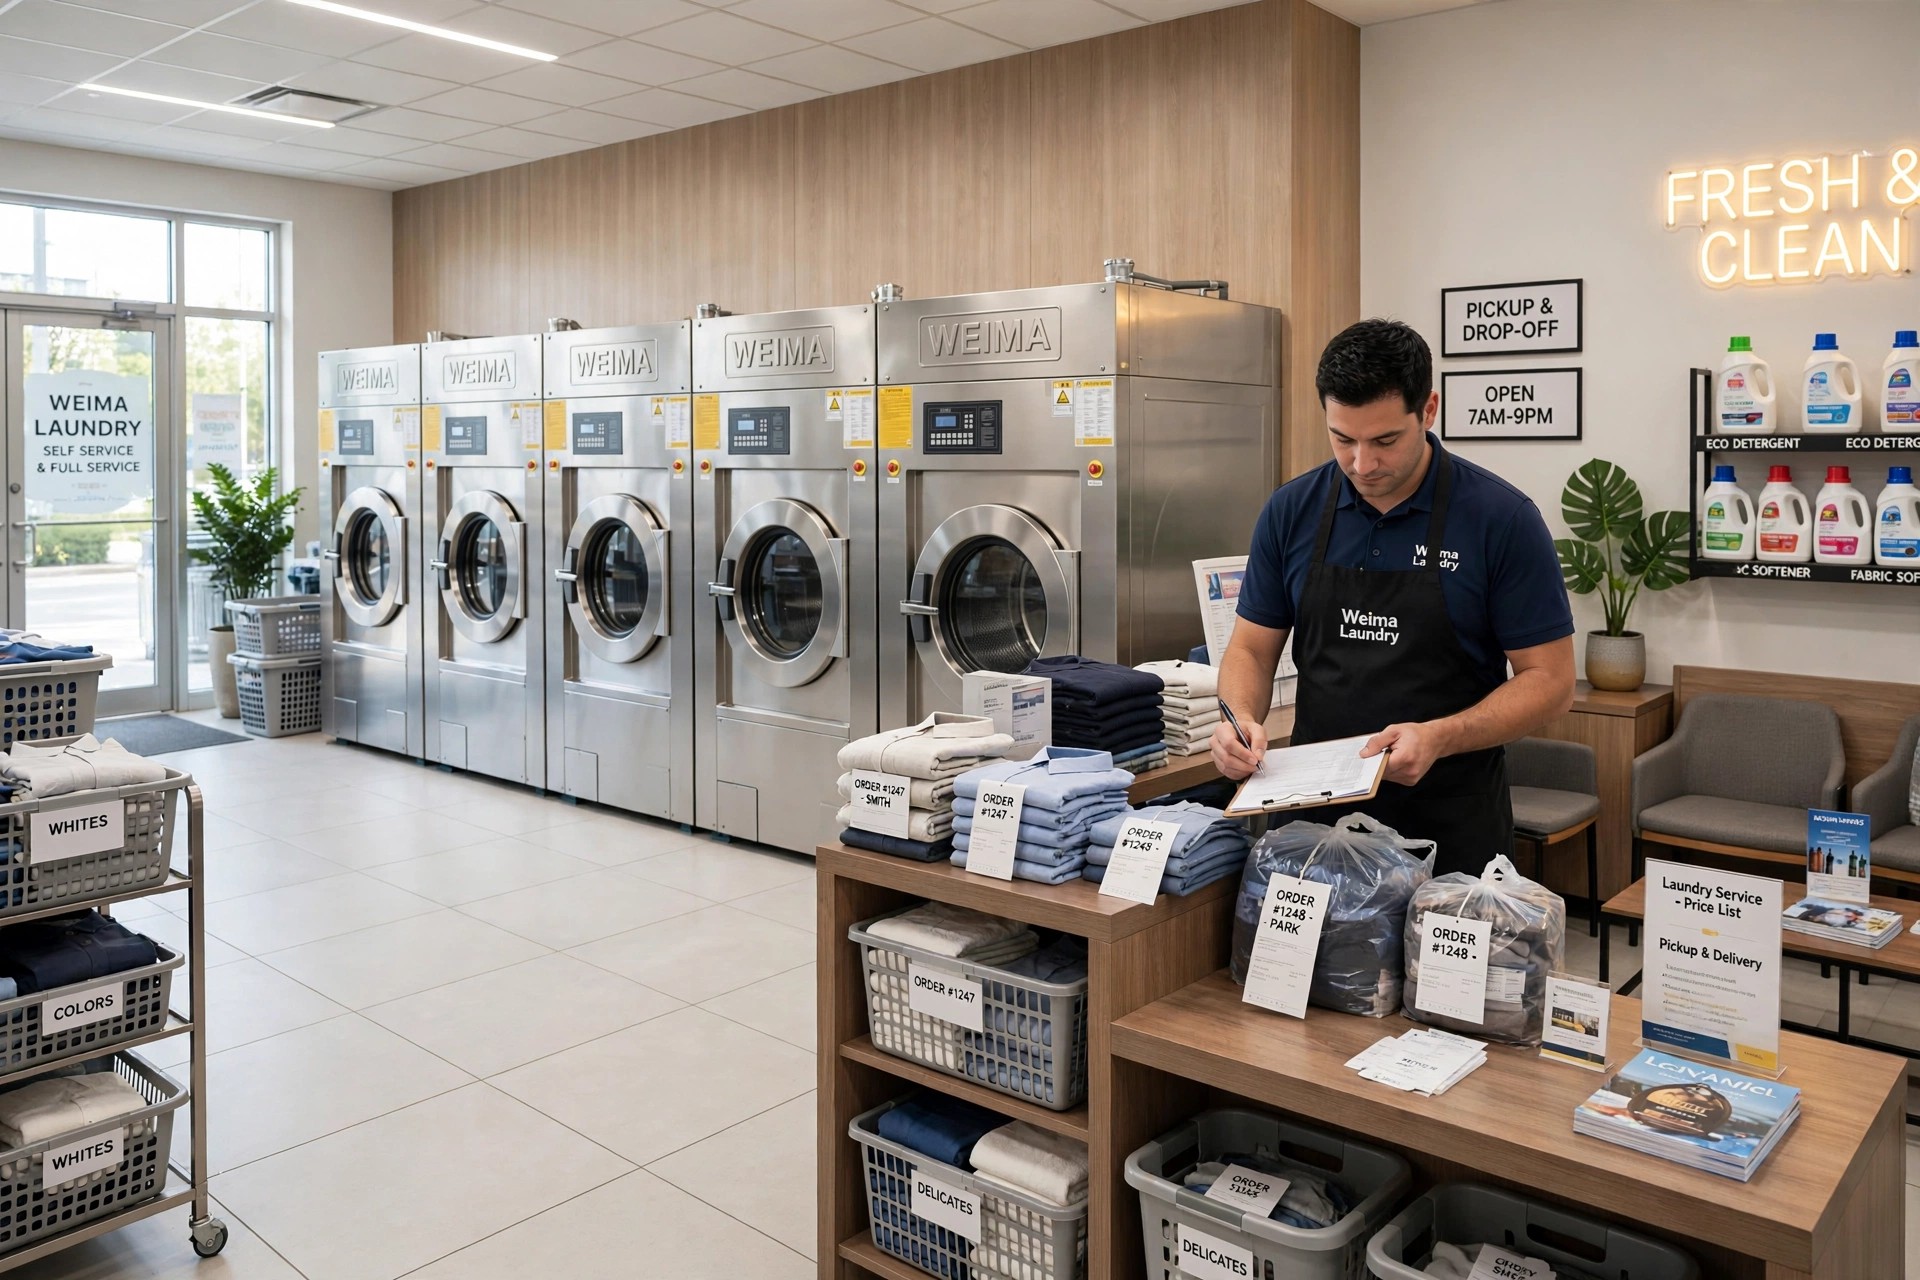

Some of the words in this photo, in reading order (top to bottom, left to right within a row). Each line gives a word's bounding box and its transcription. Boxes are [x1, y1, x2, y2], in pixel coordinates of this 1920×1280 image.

[1667, 153, 1859, 225] FRESH
[1886, 148, 1920, 204] &
[1701, 217, 1900, 283] CLEAN
[1466, 299, 1535, 319] PICKUP
[1540, 297, 1554, 314] &
[929, 318, 1053, 357] WEIMA
[1463, 319, 1559, 341] DROP-OFF
[733, 334, 829, 368] WEIMA
[450, 358, 512, 384] WEIMA
[577, 348, 654, 377] WEIMA
[342, 366, 394, 391] WEIMA
[49, 394, 128, 412] WEIMA
[1485, 385, 1534, 403] OPEN
[1468, 407, 1553, 425] 7AM-9PM
[34, 419, 142, 437] LAUNDRY
[43, 445, 75, 456] SELF
[80, 445, 134, 456] SERVICE
[1706, 438, 1729, 449] ECO
[1733, 437, 1800, 449] DETERGENT
[1846, 437, 1871, 449] ECO
[37, 463, 46, 473] &
[50, 463, 83, 473] FULL
[87, 462, 141, 472] SERVICE
[1752, 564, 1811, 578] SOFTENER
[1850, 569, 1893, 582] FABRIC
[1341, 608, 1398, 628] Weima
[1340, 624, 1400, 645] Laundry
[854, 779, 881, 792] ORDER
[866, 794, 891, 808] SMITH
[983, 793, 1014, 808] ORDER
[981, 808, 1008, 820] #1247
[48, 814, 108, 836] WHITES
[1127, 827, 1163, 841] ORDER
[1276, 889, 1315, 908] ORDER
[1662, 876, 1712, 899] Laundry
[1715, 886, 1763, 906] Service
[1273, 904, 1307, 921] #1248
[1684, 896, 1714, 914] Price
[1718, 903, 1742, 919] List
[1270, 918, 1301, 936] PARK
[1432, 927, 1476, 946] ORDER
[1432, 943, 1468, 960] #1248
[1659, 937, 1698, 959] Pickup
[1701, 947, 1710, 959] &
[1713, 949, 1762, 972] Delivery
[914, 975, 945, 995] ORDER
[948, 987, 975, 1003] #1247
[53, 994, 114, 1021] COLORS
[52, 1139, 114, 1170] WHITES
[1232, 1175, 1270, 1193] ORDER
[917, 1181, 973, 1215] DELICATES
[1183, 1239, 1247, 1276] DELICATES
